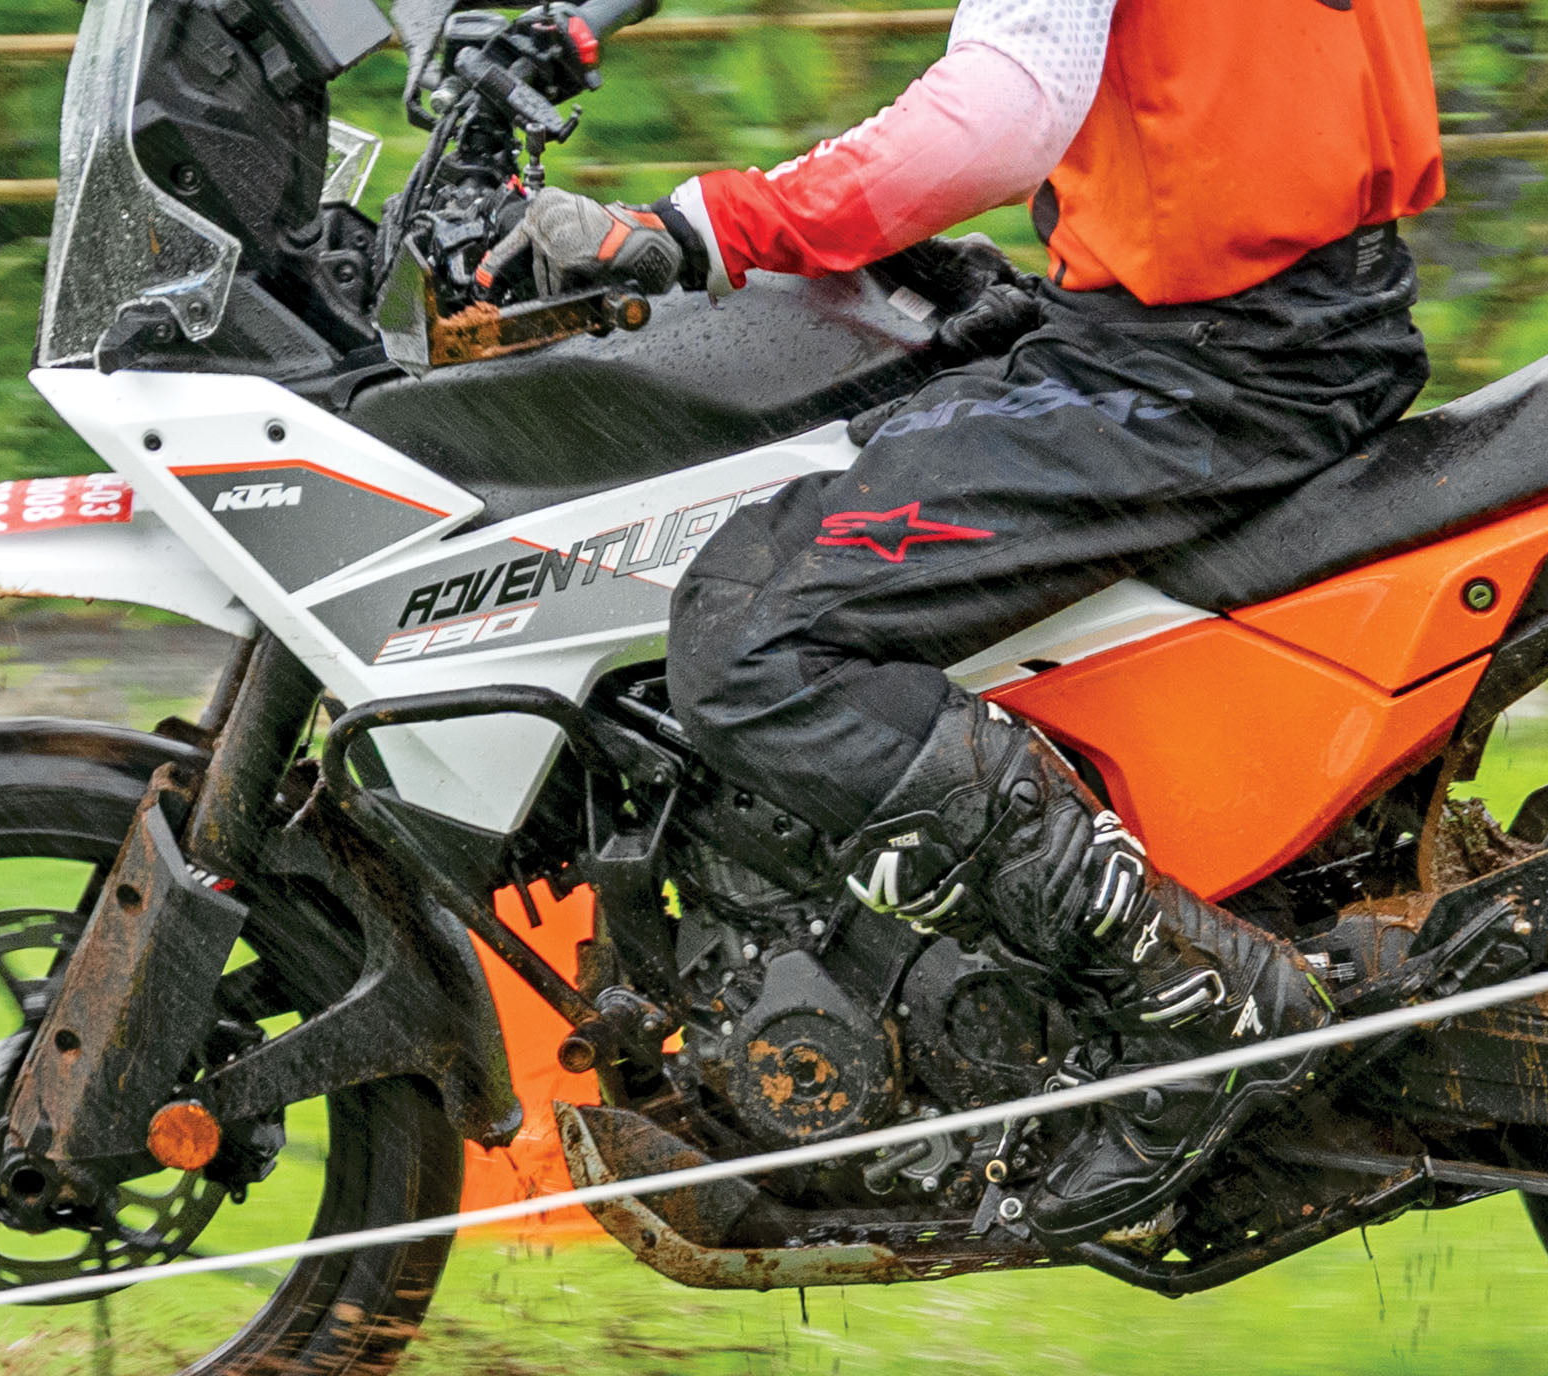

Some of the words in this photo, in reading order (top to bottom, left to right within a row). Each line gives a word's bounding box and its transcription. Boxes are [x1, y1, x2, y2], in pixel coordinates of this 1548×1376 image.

[212, 483, 302, 512] KTM
[373, 603, 539, 665] 390
[888, 831, 920, 847] TECH
